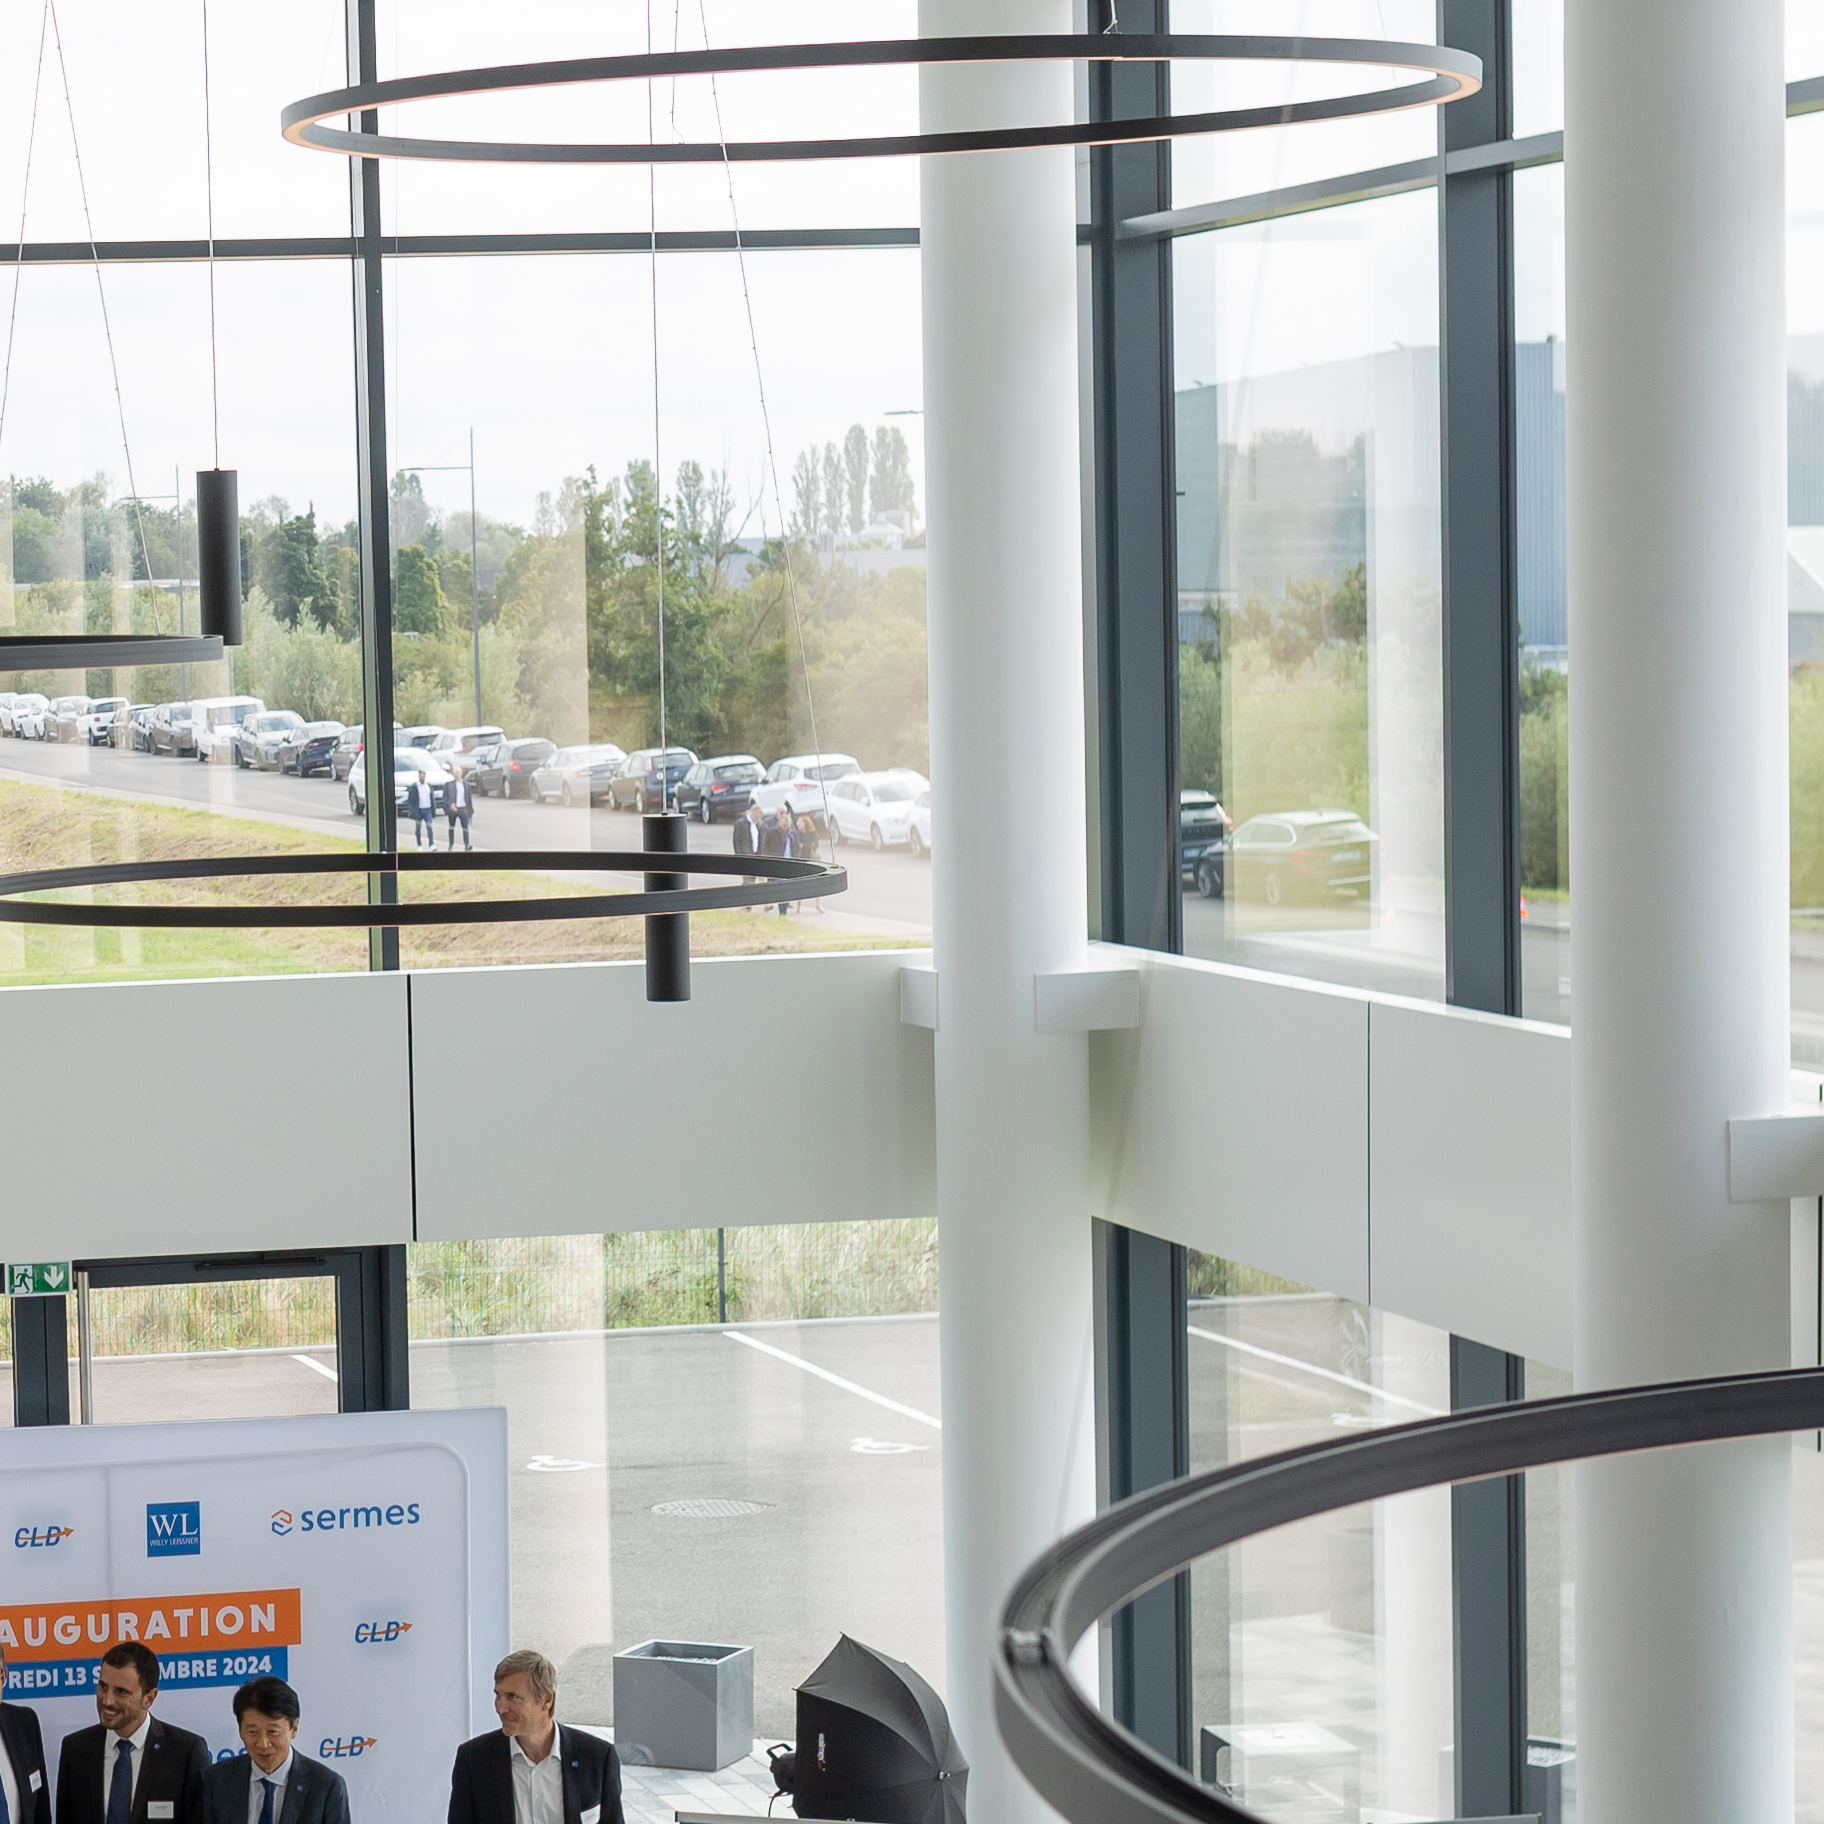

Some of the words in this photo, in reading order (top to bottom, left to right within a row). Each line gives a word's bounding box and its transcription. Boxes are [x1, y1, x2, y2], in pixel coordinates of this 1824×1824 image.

[149, 1512, 199, 1537] WL
[301, 1503, 420, 1531] sermes
[14, 1526, 63, 1548] CLD
[355, 1621, 401, 1643] CLD
[64, 1666, 87, 1686] 13
[223, 1655, 272, 1676] 2024
[319, 1736, 365, 1758] CLD
